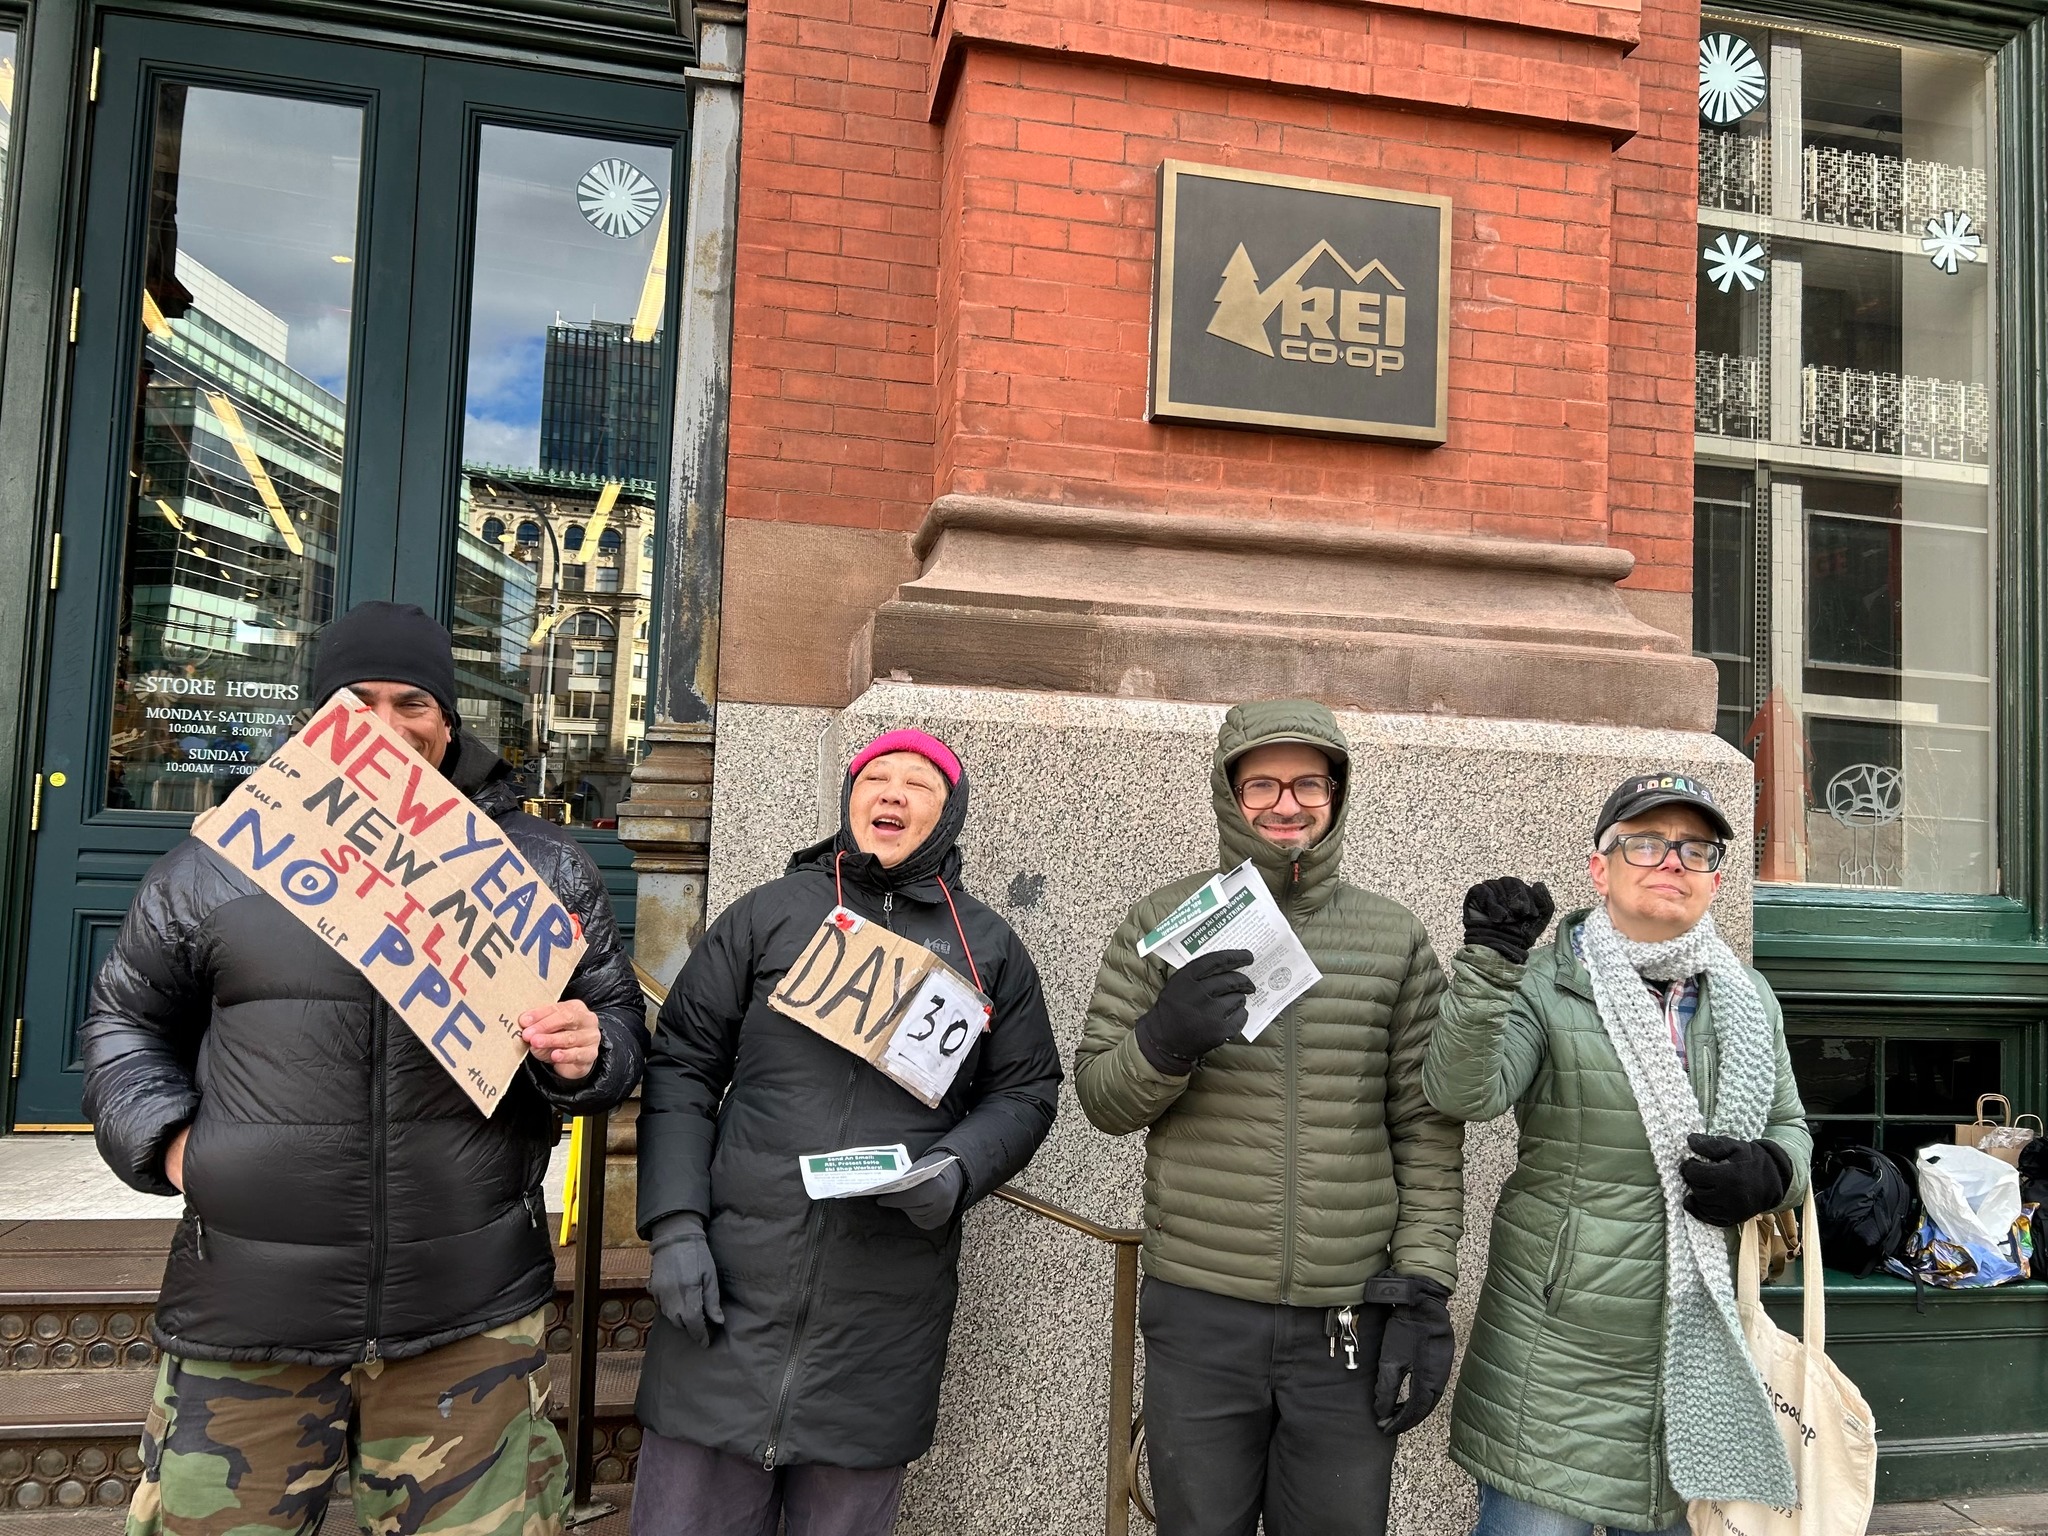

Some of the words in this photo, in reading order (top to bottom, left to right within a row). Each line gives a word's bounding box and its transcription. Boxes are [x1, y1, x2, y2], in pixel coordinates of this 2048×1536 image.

[1281, 284, 1406, 347] REI
[146, 676, 216, 696] STORE
[226, 681, 299, 700] HOURS
[146, 707, 295, 726] MONDAY-SATURDAY
[168, 723, 217, 735] 10:00AM
[231, 727, 272, 738] 8:00PM
[166, 762, 214, 774] 10:00AM
[189, 749, 249, 761] SUNDAY
[1636, 777, 1699, 796] LOCAL
[217, 808, 338, 905] NO
[303, 704, 460, 837] NEW
[439, 811, 573, 980] YEAR
[302, 776, 438, 887] NEW
[428, 889, 515, 979] ME
[320, 844, 467, 996] STILL
[1182, 935, 1194, 946] REI
[1204, 917, 1215, 927] Ski
[1196, 933, 1209, 945] ARE
[1206, 926, 1217, 936] ON
[1215, 917, 1227, 929] ULP
[1225, 901, 1246, 920] STRIKE!
[932, 941, 951, 951] REI
[317, 917, 348, 947] ULP
[359, 924, 486, 1068] PPE
[777, 922, 928, 1043] DAY
[907, 995, 969, 1057] 30
